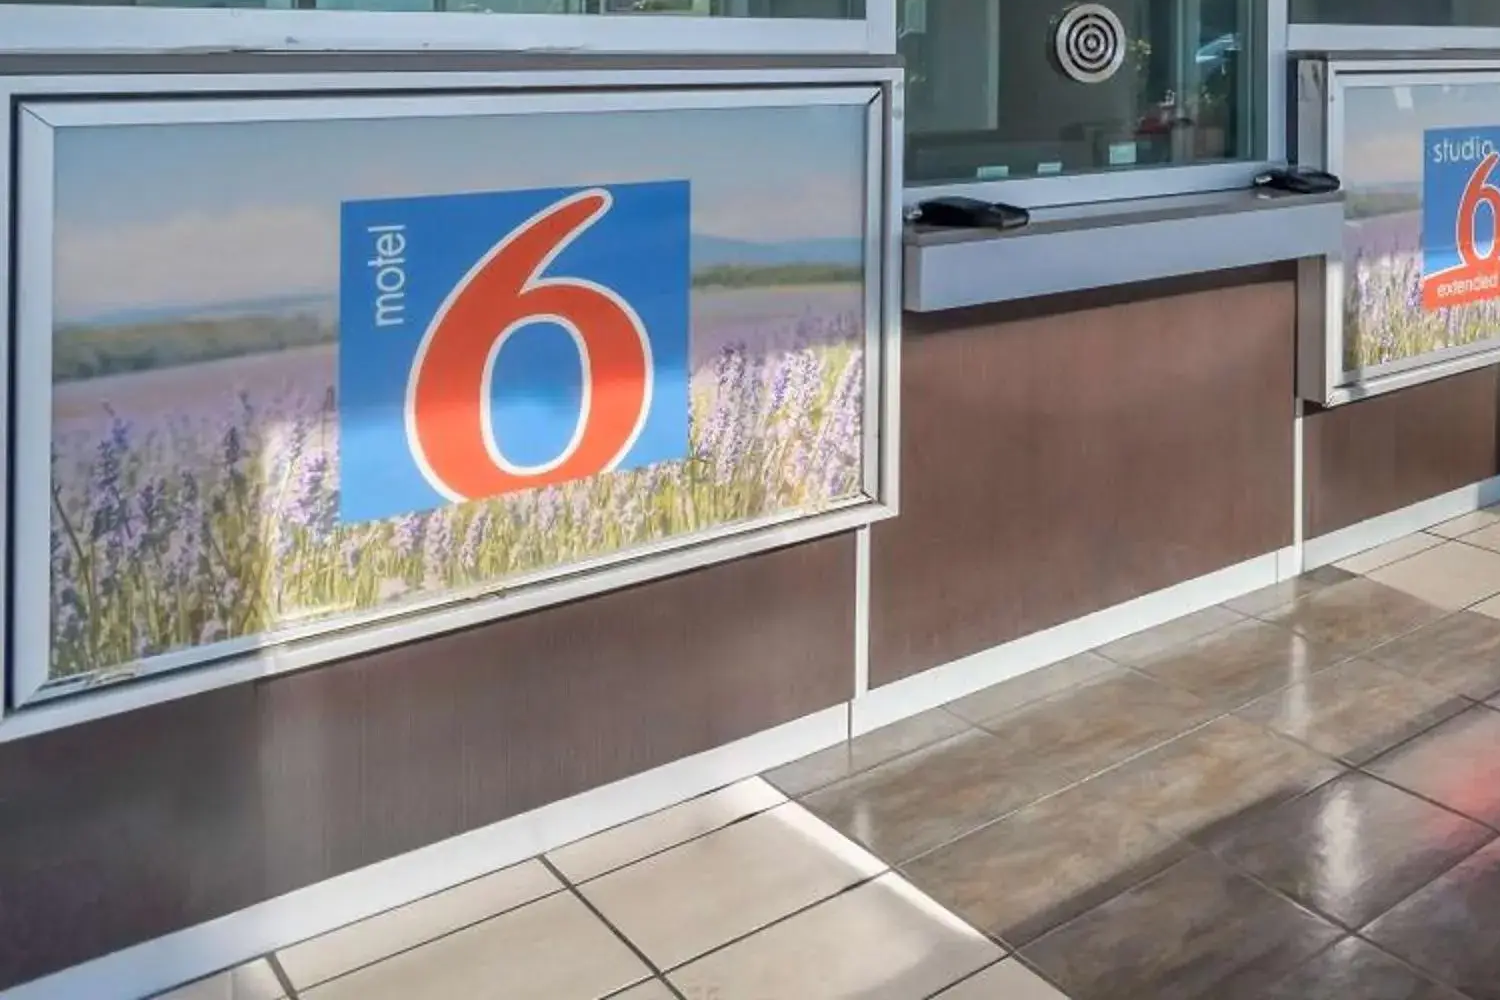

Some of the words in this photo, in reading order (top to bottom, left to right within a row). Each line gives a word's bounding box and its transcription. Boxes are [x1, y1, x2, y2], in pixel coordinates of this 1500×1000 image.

[1433, 136, 1496, 163] studio
[1436, 271, 1498, 298] extended
[368, 223, 406, 327] motel
[404, 188, 654, 502] 6
